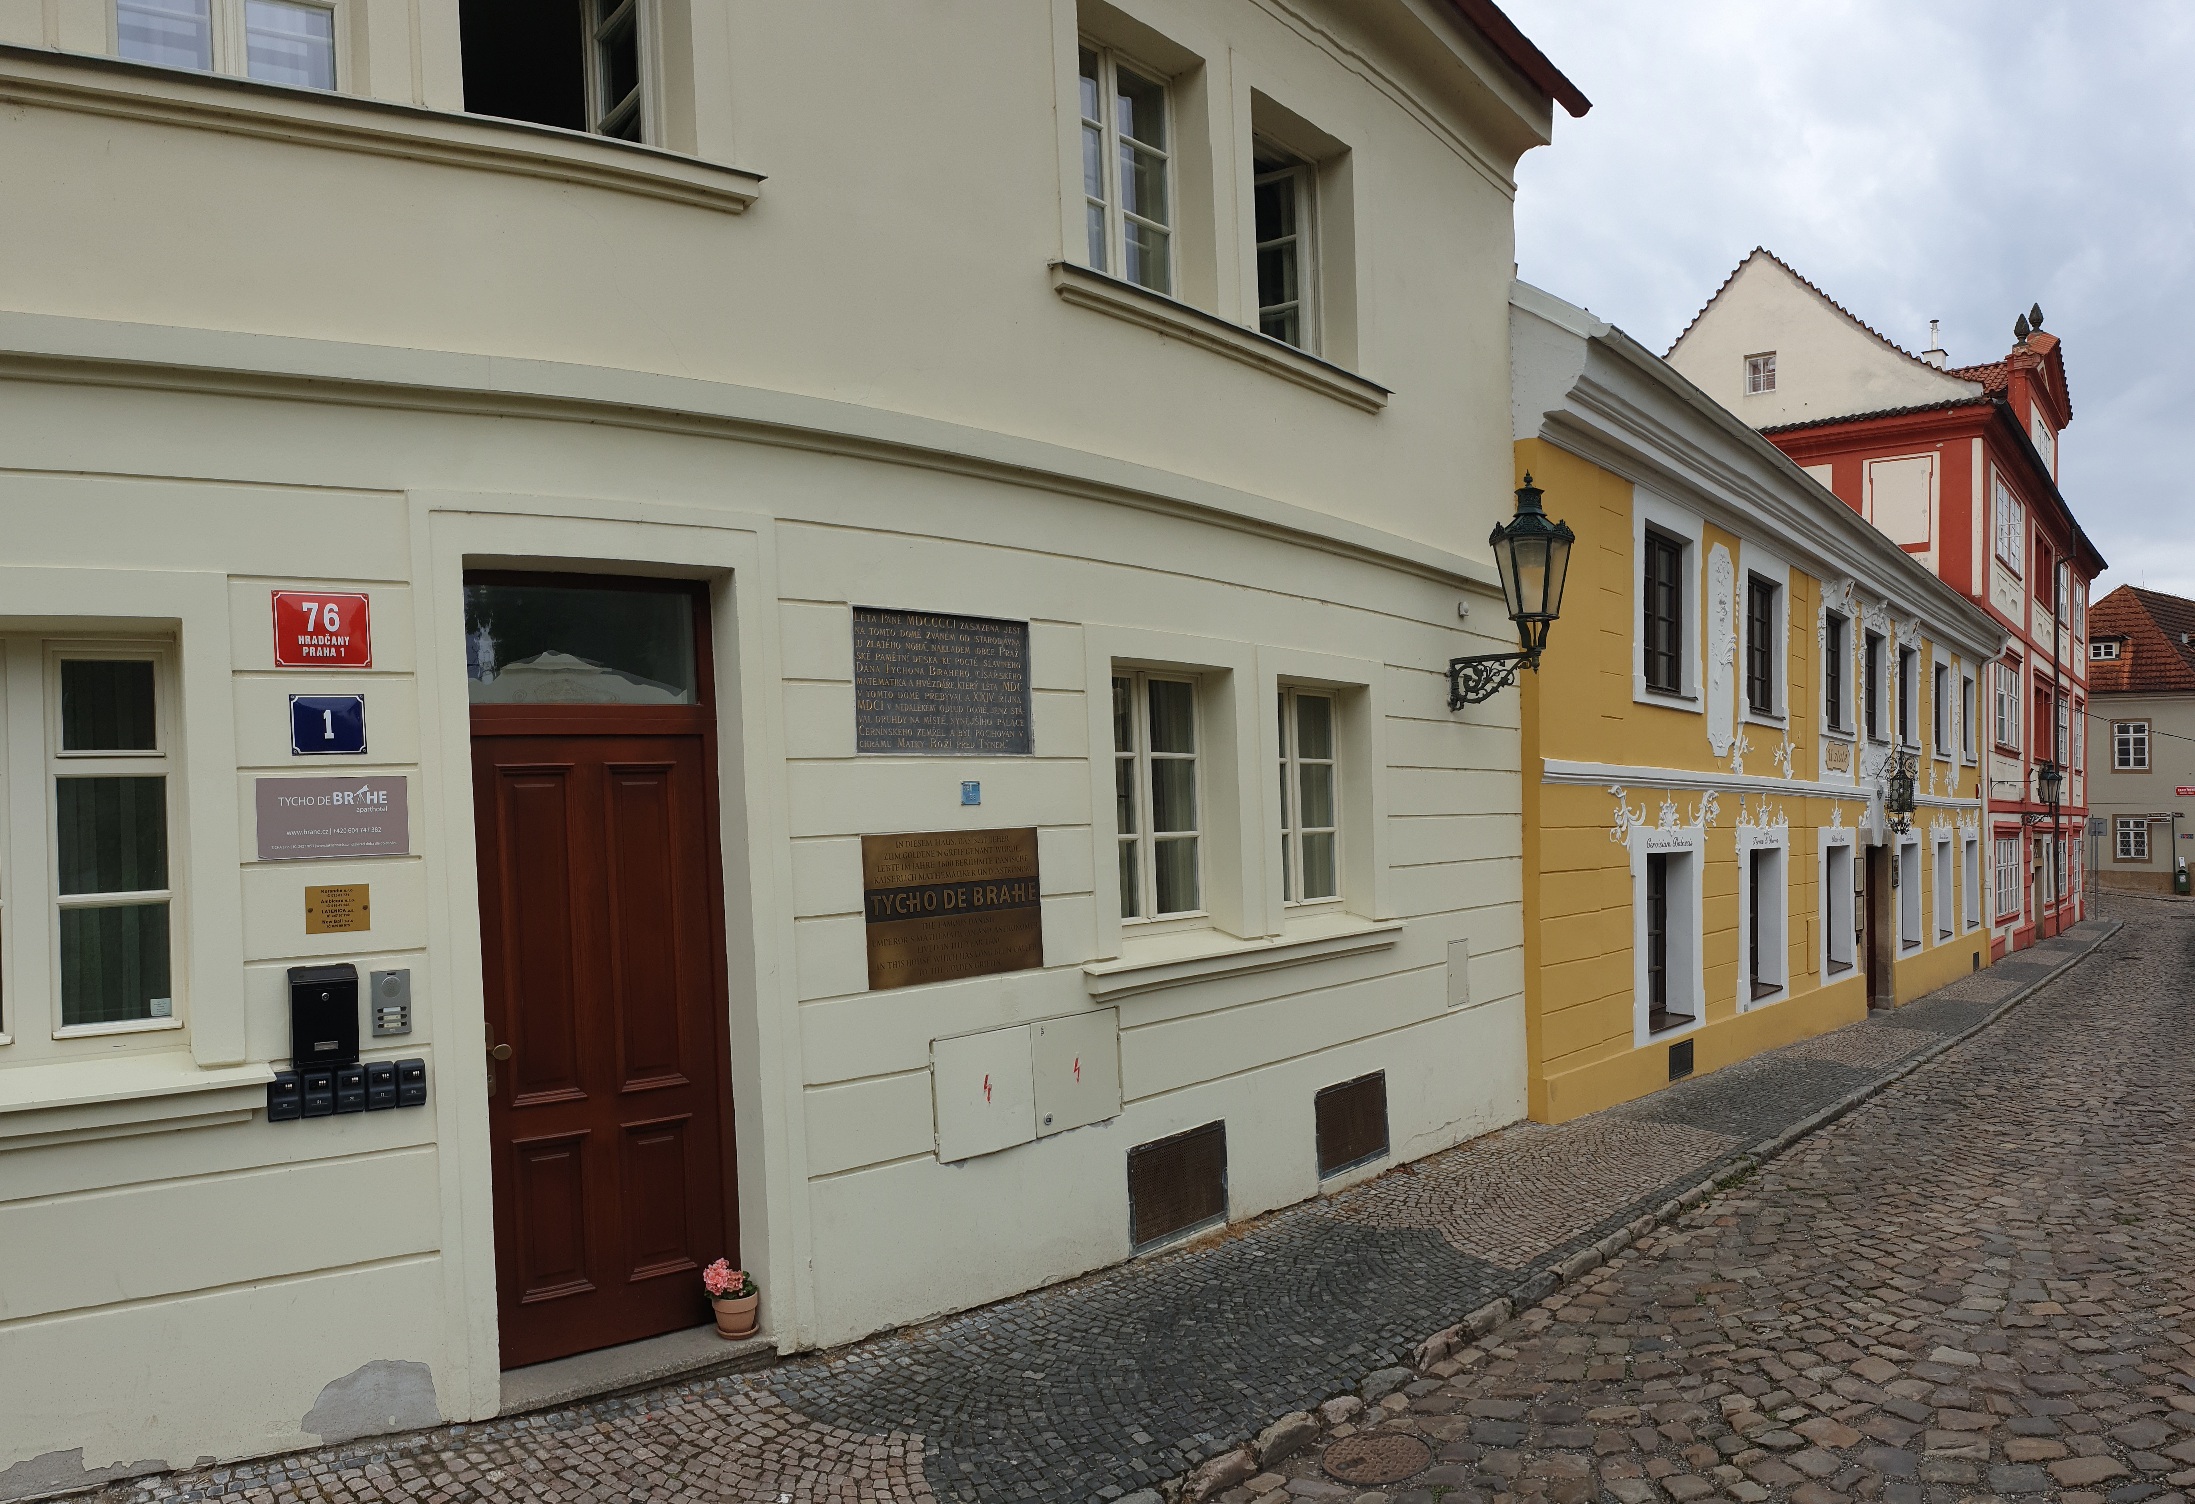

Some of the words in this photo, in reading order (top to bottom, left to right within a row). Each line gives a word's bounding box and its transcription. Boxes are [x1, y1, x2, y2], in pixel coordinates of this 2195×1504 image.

[302, 602, 340, 632] 76
[869, 628, 895, 636] TOMTO
[298, 634, 349, 645] HRADČANY
[303, 647, 336, 656] PRAHA
[340, 648, 344, 656] 1
[932, 643, 970, 654] NÁKLADEM
[913, 656, 937, 664] DESKA
[885, 664, 924, 675] TYCHONA
[857, 678, 906, 686] MATEMATIKA
[857, 700, 883, 710] MDCI
[323, 709, 334, 739] 1
[898, 738, 924, 747] MATKY
[278, 797, 314, 806] TYCHO
[318, 796, 331, 805] DE
[878, 864, 899, 872] LEBTE
[902, 863, 911, 871] IM
[912, 862, 934, 871] JAHRE
[870, 891, 937, 915] TYCHO
[944, 888, 967, 909] DE
[973, 883, 1036, 906] BRAHE
[922, 922, 935, 930] THE
[887, 960, 905, 969] THIS
